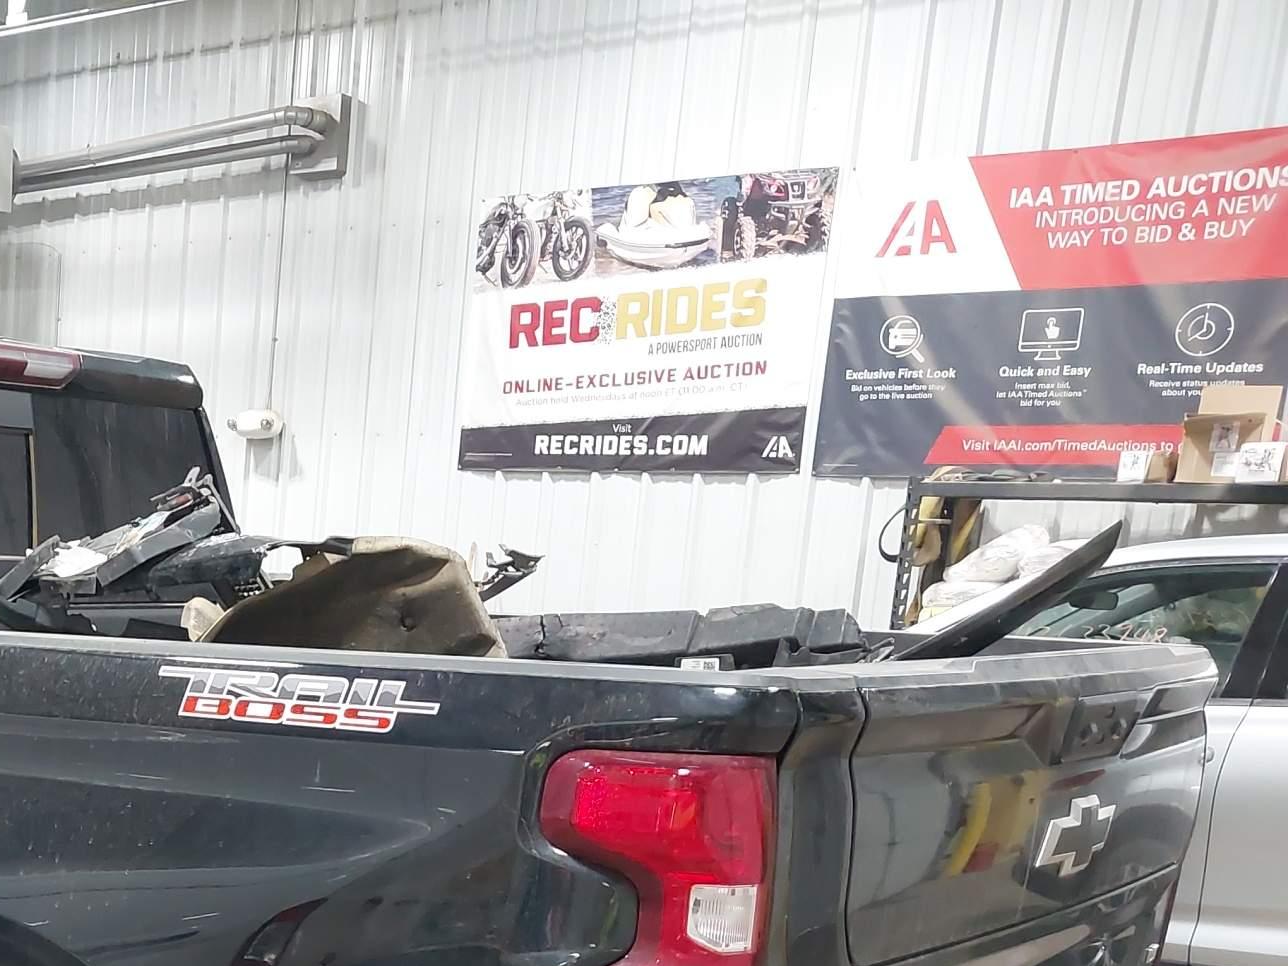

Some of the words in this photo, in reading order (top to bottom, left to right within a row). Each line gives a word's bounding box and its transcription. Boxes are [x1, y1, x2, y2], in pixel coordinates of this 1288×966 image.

[1009, 187, 1054, 208] IAA
[1061, 179, 1140, 206] TIMED
[1036, 201, 1185, 228] INTRODUCING
[1192, 199, 1210, 217] A
[1217, 193, 1277, 215] NEW
[1047, 229, 1095, 249] WAY
[1100, 227, 1128, 246] TO
[1134, 224, 1173, 244] BID
[1177, 222, 1197, 241] &
[1204, 218, 1255, 240] BUY
[509, 296, 603, 349] REC
[615, 278, 767, 340] RIDES
[647, 343, 654, 356] A
[656, 336, 717, 355] POWERSPORT
[720, 332, 763, 349] AUCTION
[845, 368, 896, 380] Exclusive
[898, 367, 924, 379] First
[926, 367, 957, 379] Look
[999, 366, 1034, 377] Quick
[1037, 365, 1060, 376] and
[1062, 365, 1092, 378] Easy
[1137, 362, 1202, 375] Real-Time
[1206, 361, 1264, 375] Updates
[503, 368, 677, 395] ONLINE-EXCLUSIVE
[683, 360, 767, 381] AUCTION
[1149, 379, 1180, 388] Receive
[1182, 379, 1208, 387] status
[904, 383, 927, 391] before
[1015, 381, 1037, 390] Insert
[1162, 388, 1186, 396] about
[859, 393, 869, 401] go
[878, 392, 890, 400] the
[906, 391, 933, 399] auction
[1024, 390, 1047, 398] Timed
[515, 397, 548, 407] Auction
[1019, 399, 1032, 407] bid
[1046, 399, 1062, 407] you
[612, 424, 632, 433] Visit
[533, 434, 709, 456] RECRIDES.COM
[963, 438, 992, 451] Visit
[1160, 440, 1174, 452] to
[158, 665, 441, 715] TRAIL
[178, 694, 398, 733] BOSS
